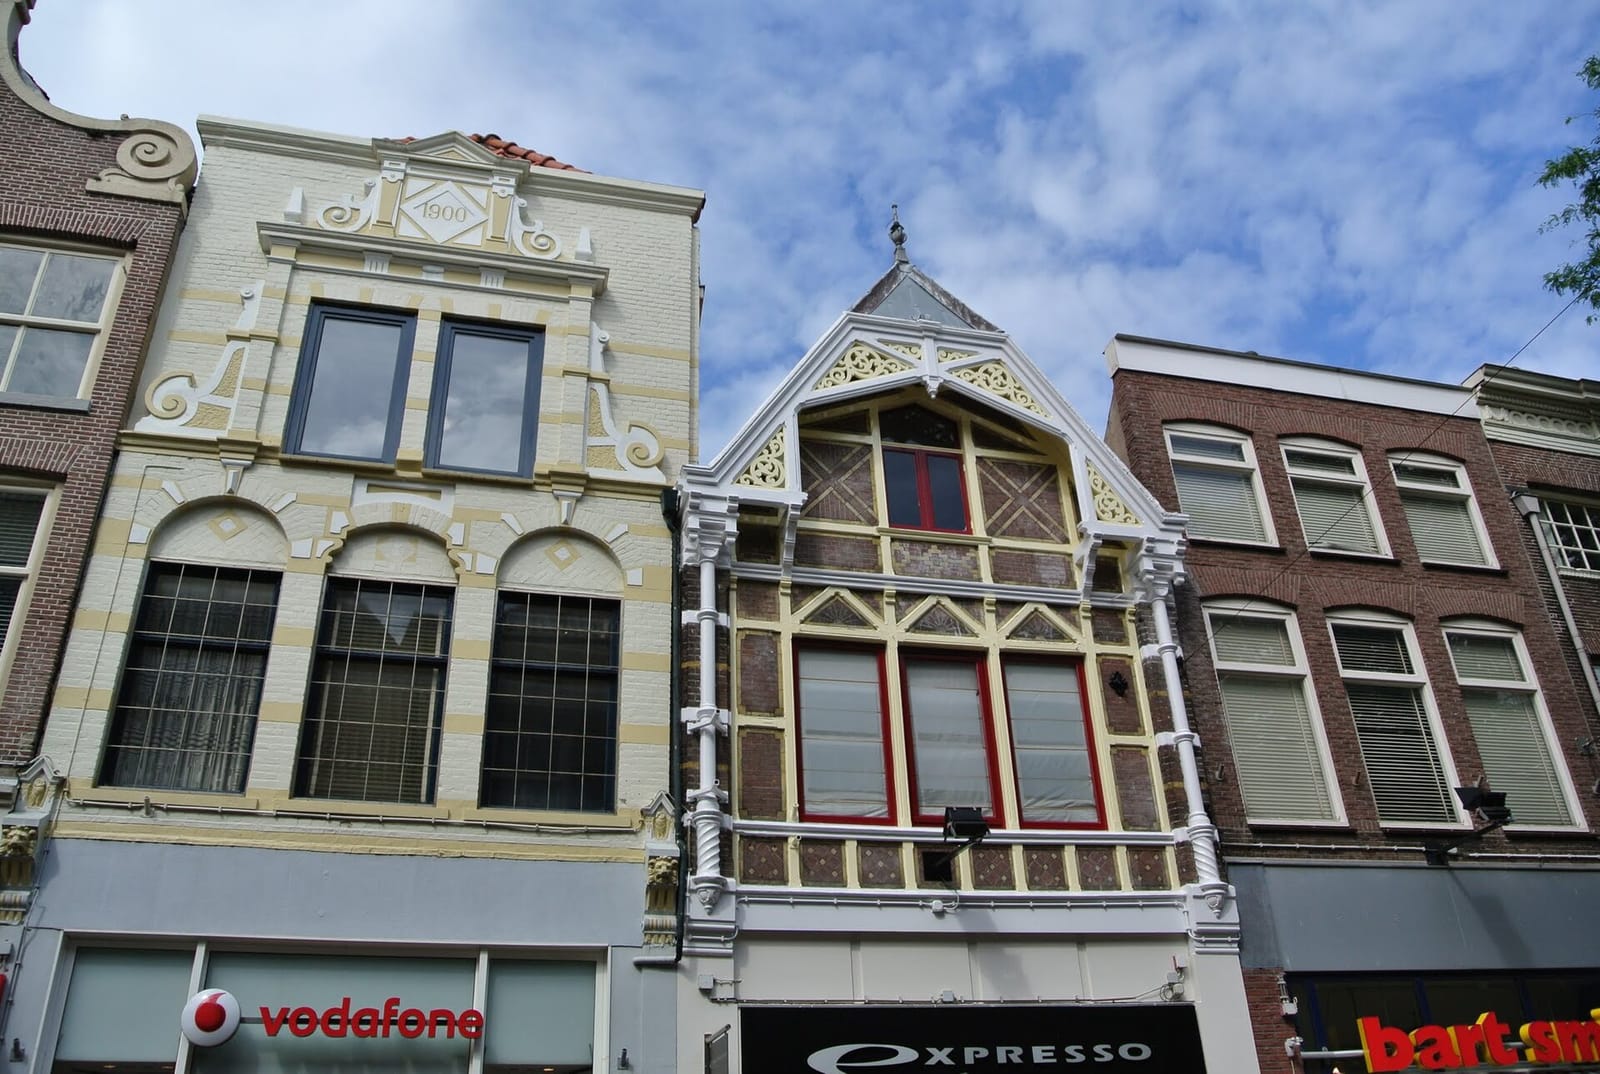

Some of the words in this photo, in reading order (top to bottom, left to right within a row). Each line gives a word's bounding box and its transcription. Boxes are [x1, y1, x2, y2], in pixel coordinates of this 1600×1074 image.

[422, 202, 466, 223] 1900
[259, 997, 484, 1039] vodafone
[1357, 1012, 1519, 1073] bart
[1519, 1008, 1600, 1064] sm
